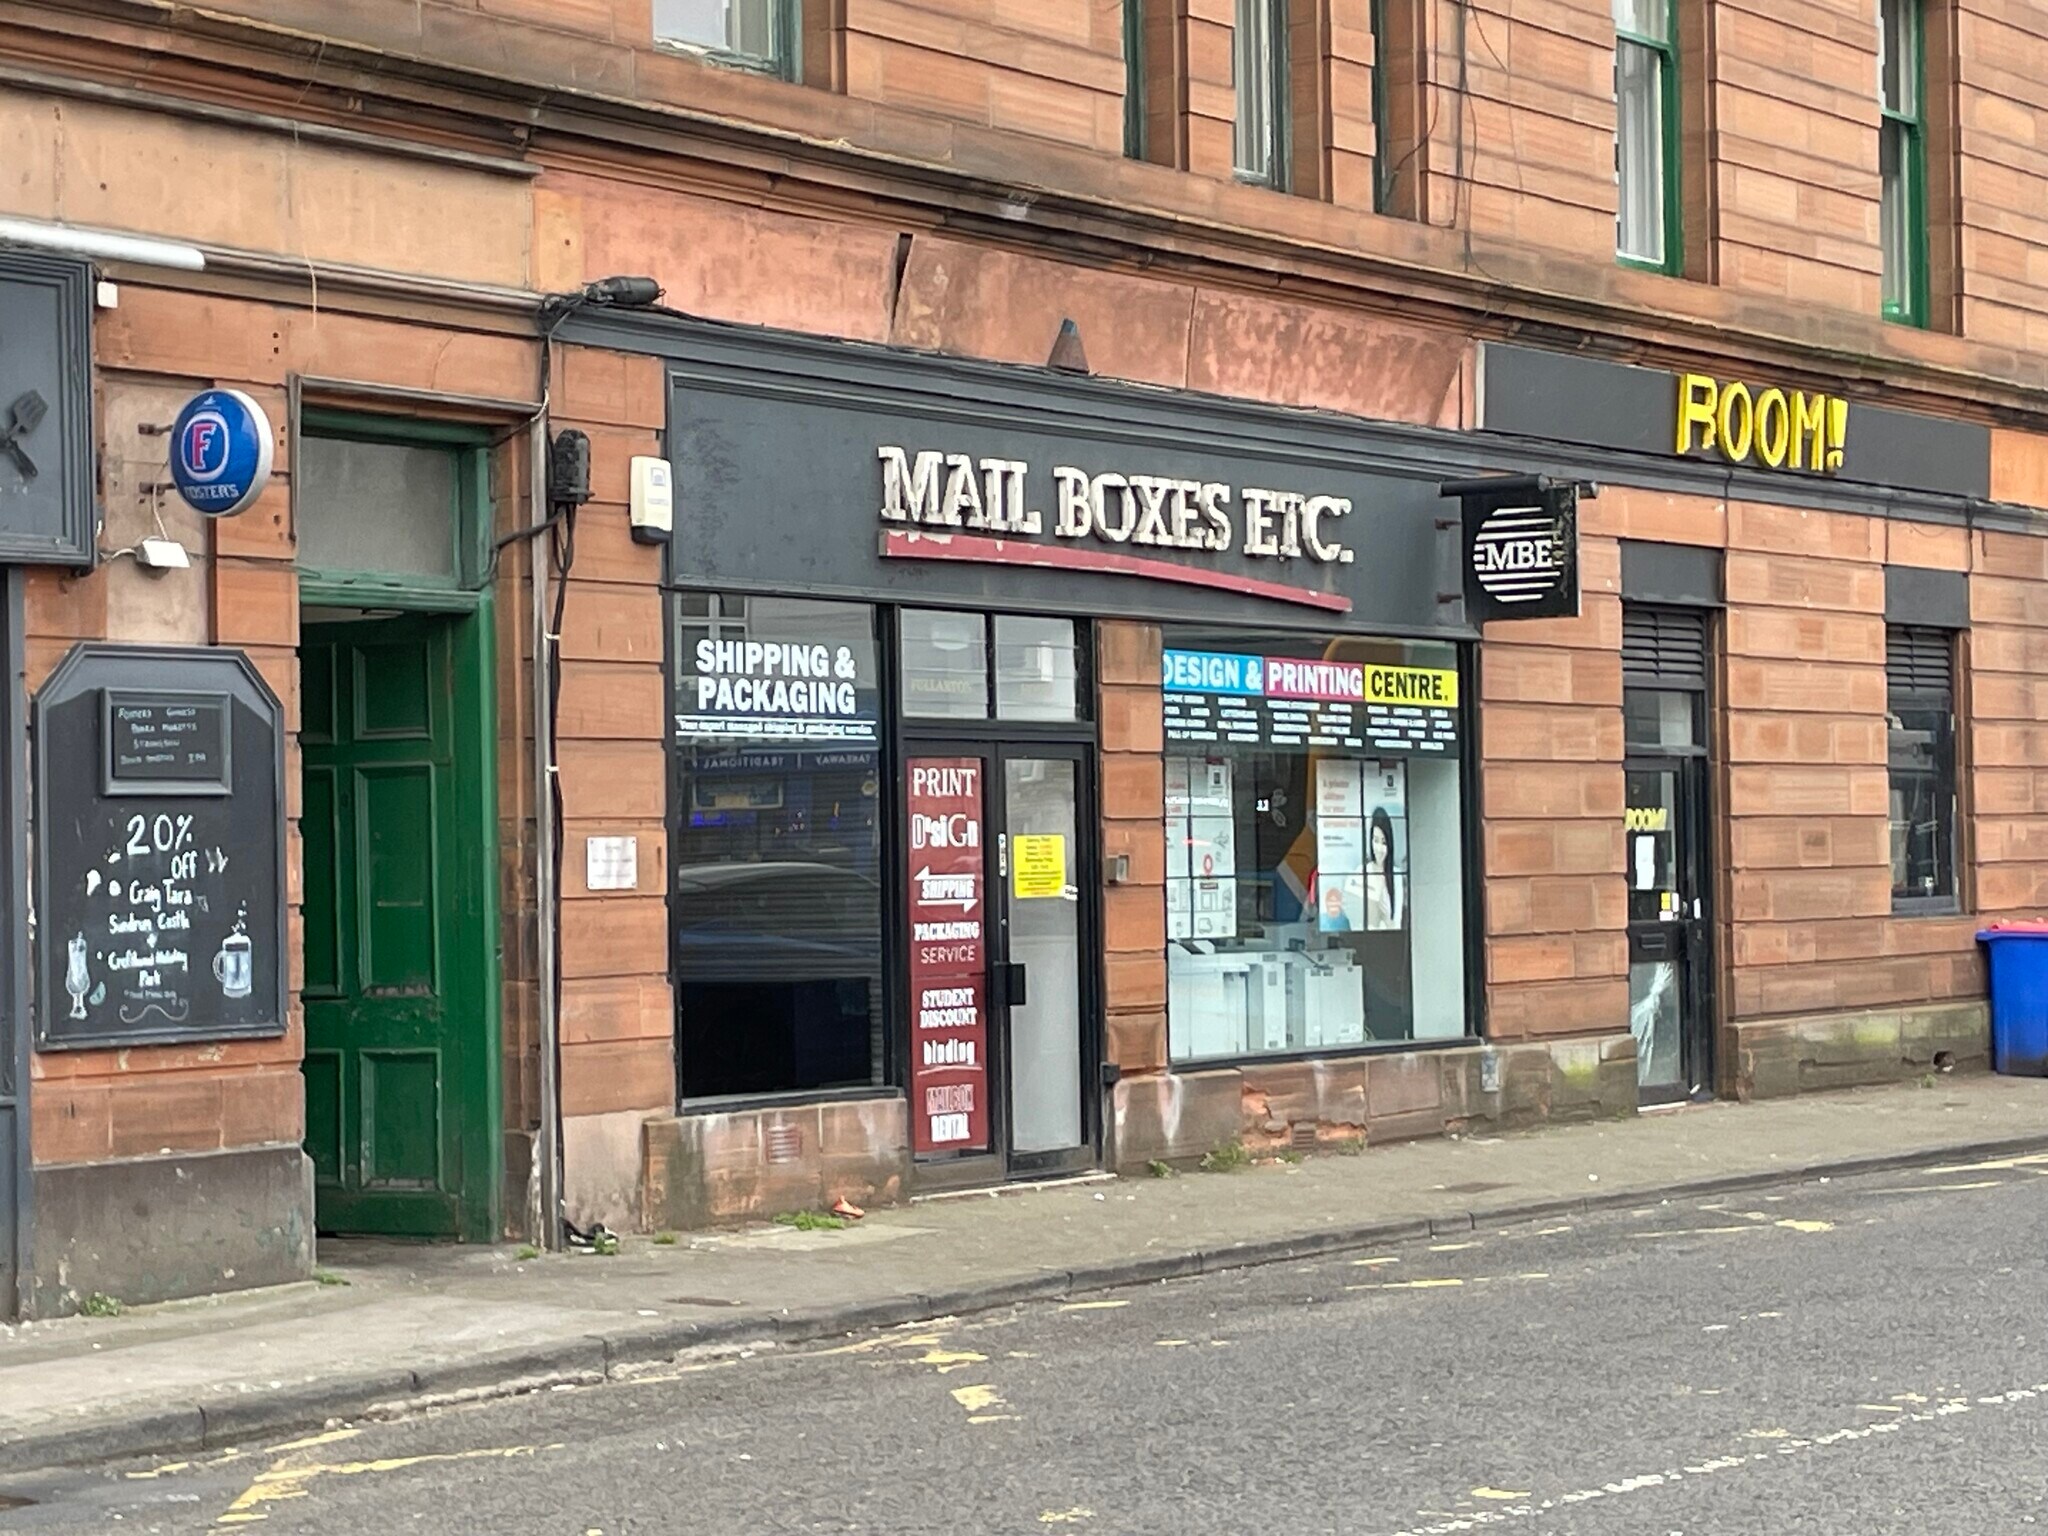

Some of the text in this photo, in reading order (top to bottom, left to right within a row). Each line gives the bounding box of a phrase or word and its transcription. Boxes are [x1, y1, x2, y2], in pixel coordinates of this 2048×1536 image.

[1677, 373, 1848, 476] ROOM!
[192, 422, 217, 470] F
[878, 446, 1354, 563] MAIL BOXES ETC.
[1484, 539, 1553, 571] MBE
[696, 639, 856, 679] SHIPPING &
[1163, 653, 1449, 702] DESIGN & PRINTING CENTRE.
[698, 676, 857, 715] PACKAGING
[913, 767, 977, 798] PRINT
[127, 814, 194, 855] 20%
[129, 878, 193, 912] Craig Tara
[922, 880, 975, 900] SHIPPING
[914, 921, 980, 942] PACKAGING
[921, 945, 976, 965] SERVICE
[922, 987, 975, 1009] STUDENT
[919, 1006, 978, 1029] DISCOUNT
[923, 1038, 975, 1066] binding
